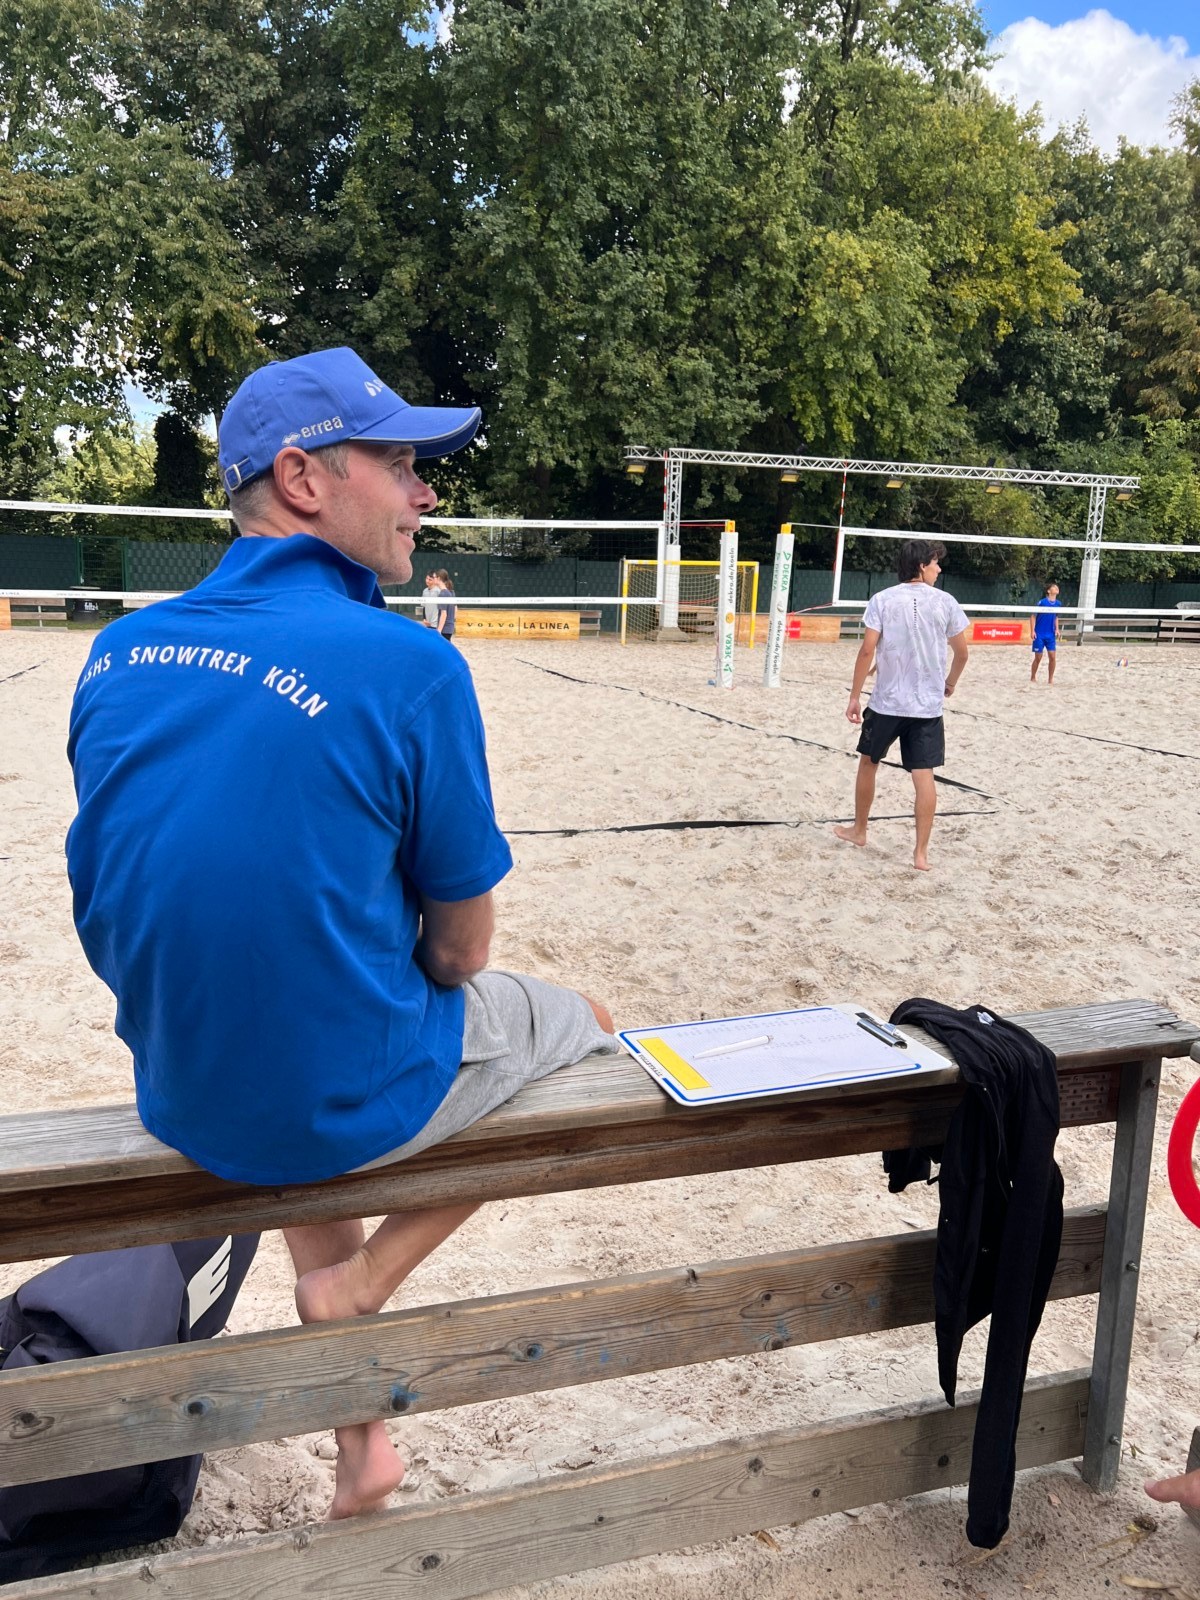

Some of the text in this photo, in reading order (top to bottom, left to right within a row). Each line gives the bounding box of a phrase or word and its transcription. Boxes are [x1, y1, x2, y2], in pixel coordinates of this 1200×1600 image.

[781, 563, 790, 592] DEKRA
[523, 622, 536, 630] LA
[539, 622, 570, 630] LINEA
[128, 645, 252, 676] SNOWTREX
[262, 665, 328, 718] KÖLN
